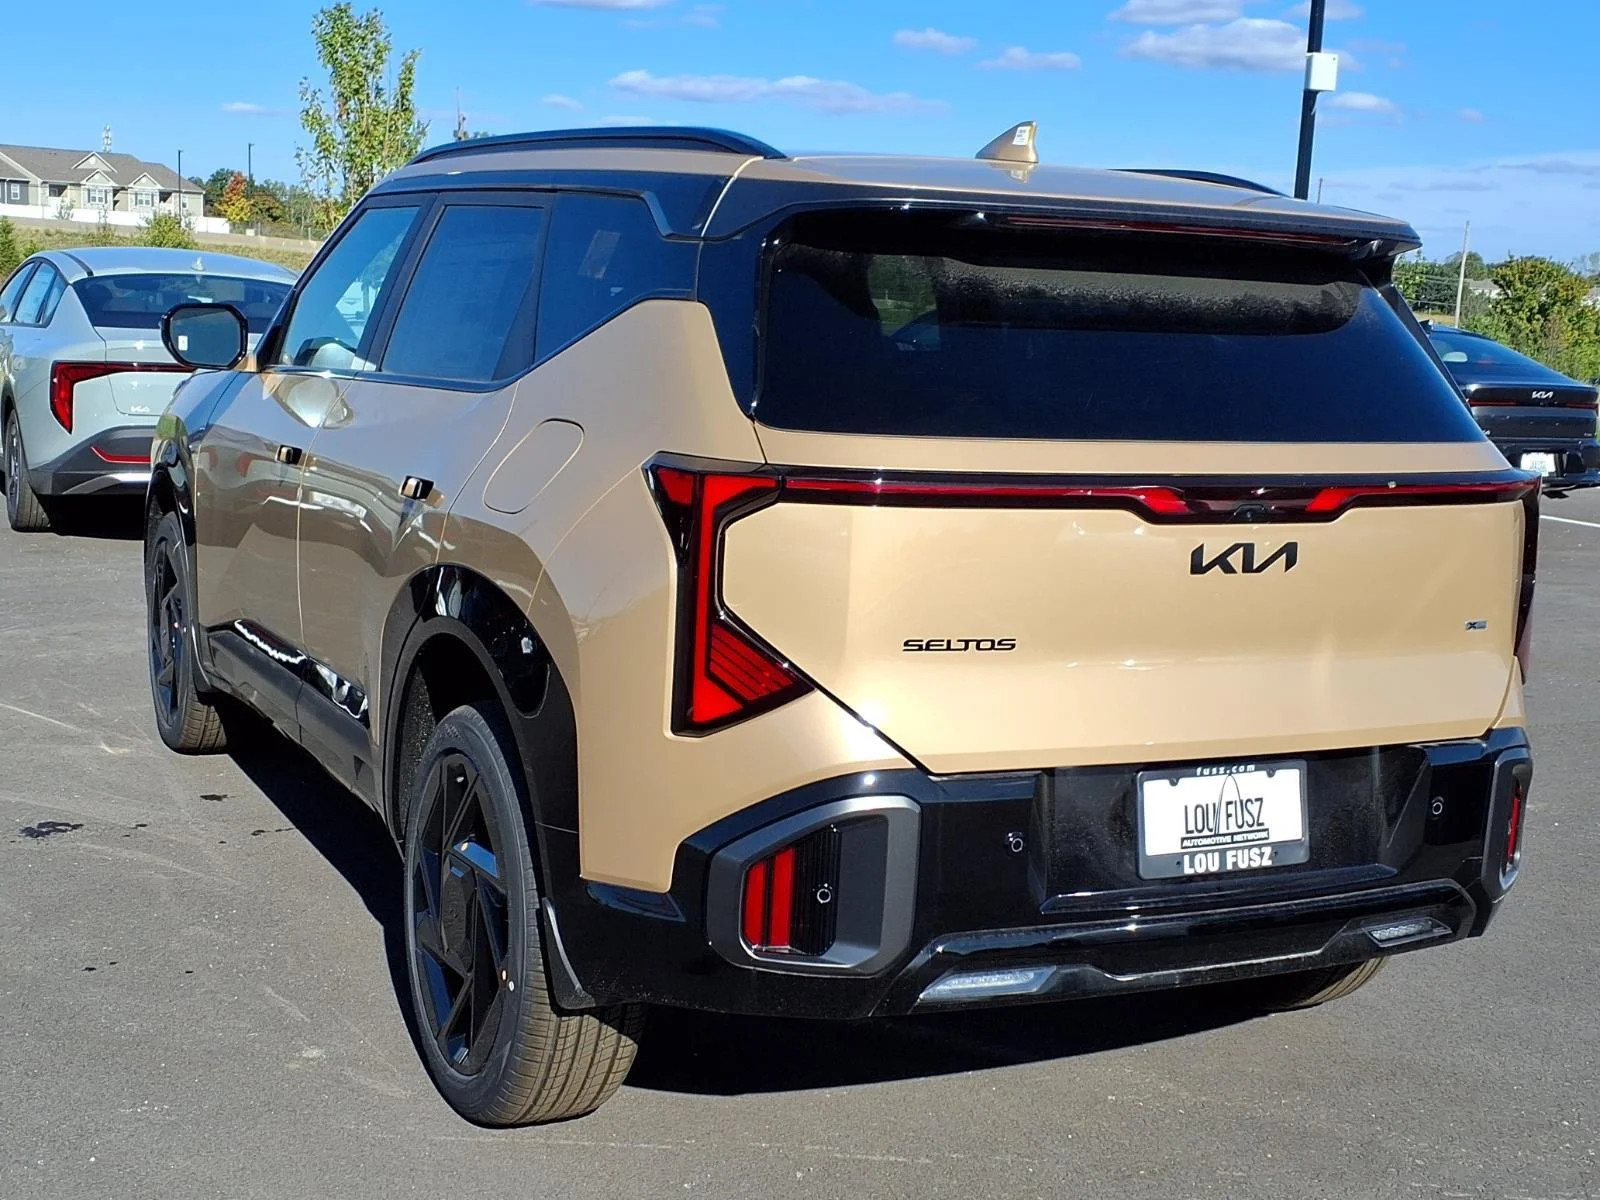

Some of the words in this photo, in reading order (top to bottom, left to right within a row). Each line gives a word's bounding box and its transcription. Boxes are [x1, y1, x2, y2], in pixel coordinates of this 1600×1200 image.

[1190, 541, 1298, 575] KIA
[902, 638, 1017, 652] SELTOS
[1196, 764, 1255, 776] fusz.com
[1184, 802, 1217, 834] LOU
[1225, 797, 1265, 830] FUSZ
[1182, 835, 1232, 847] AUTOMOTIVE
[1183, 851, 1220, 874] LOU
[1226, 846, 1273, 870] FUSZ
